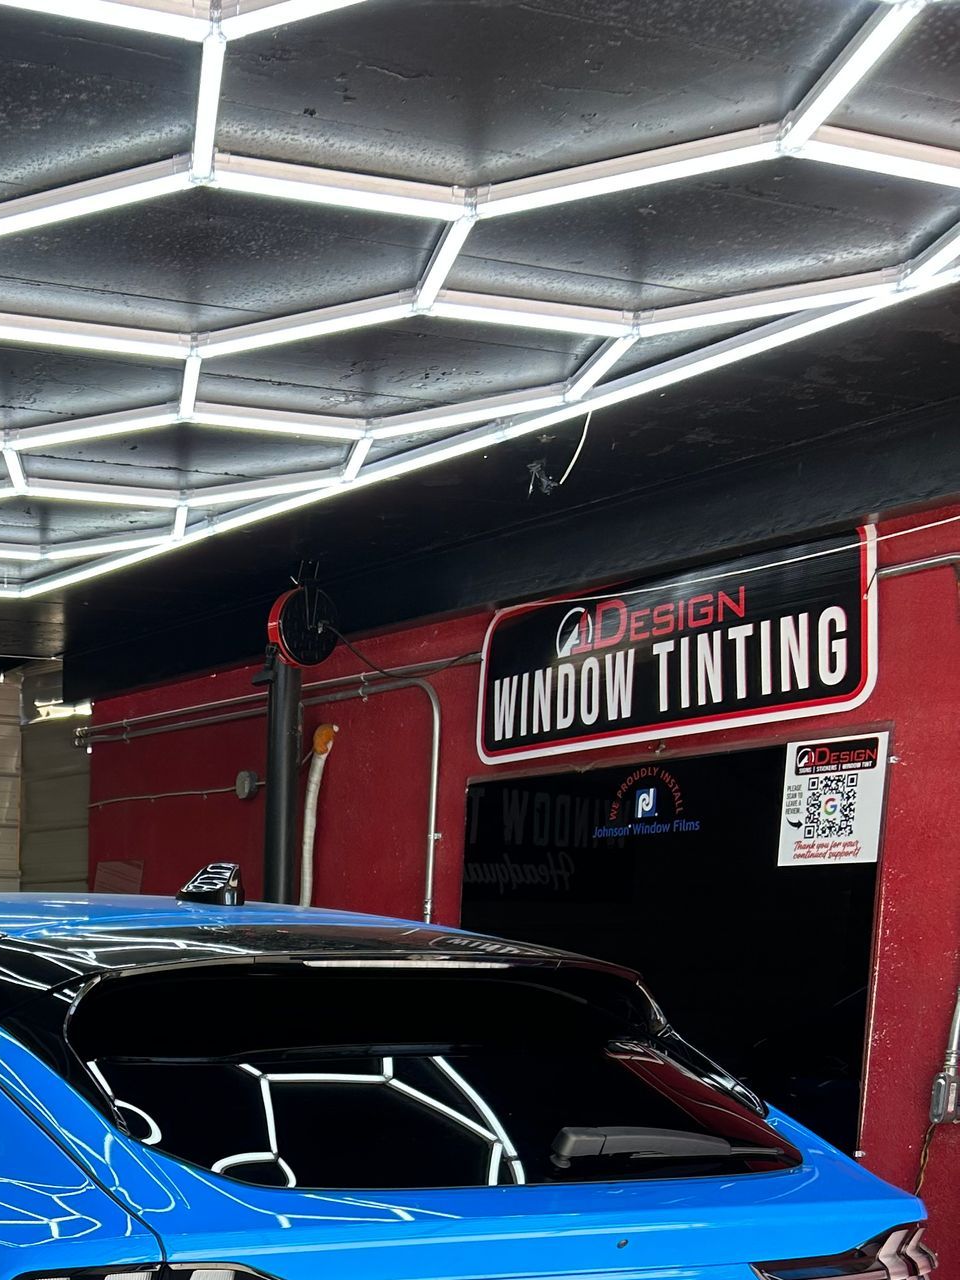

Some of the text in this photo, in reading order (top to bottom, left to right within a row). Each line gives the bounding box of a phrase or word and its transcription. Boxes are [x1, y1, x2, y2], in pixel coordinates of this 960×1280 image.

[493, 605, 848, 742] WINDOW TINTING
[609, 766, 685, 820] WE PROUDLY INSTALL
[592, 818, 701, 839] Johnson Window Films
[793, 850, 828, 860] continued
[794, 840, 816, 851] Thank
[816, 842, 829, 851] you
[842, 839, 859, 851] your
